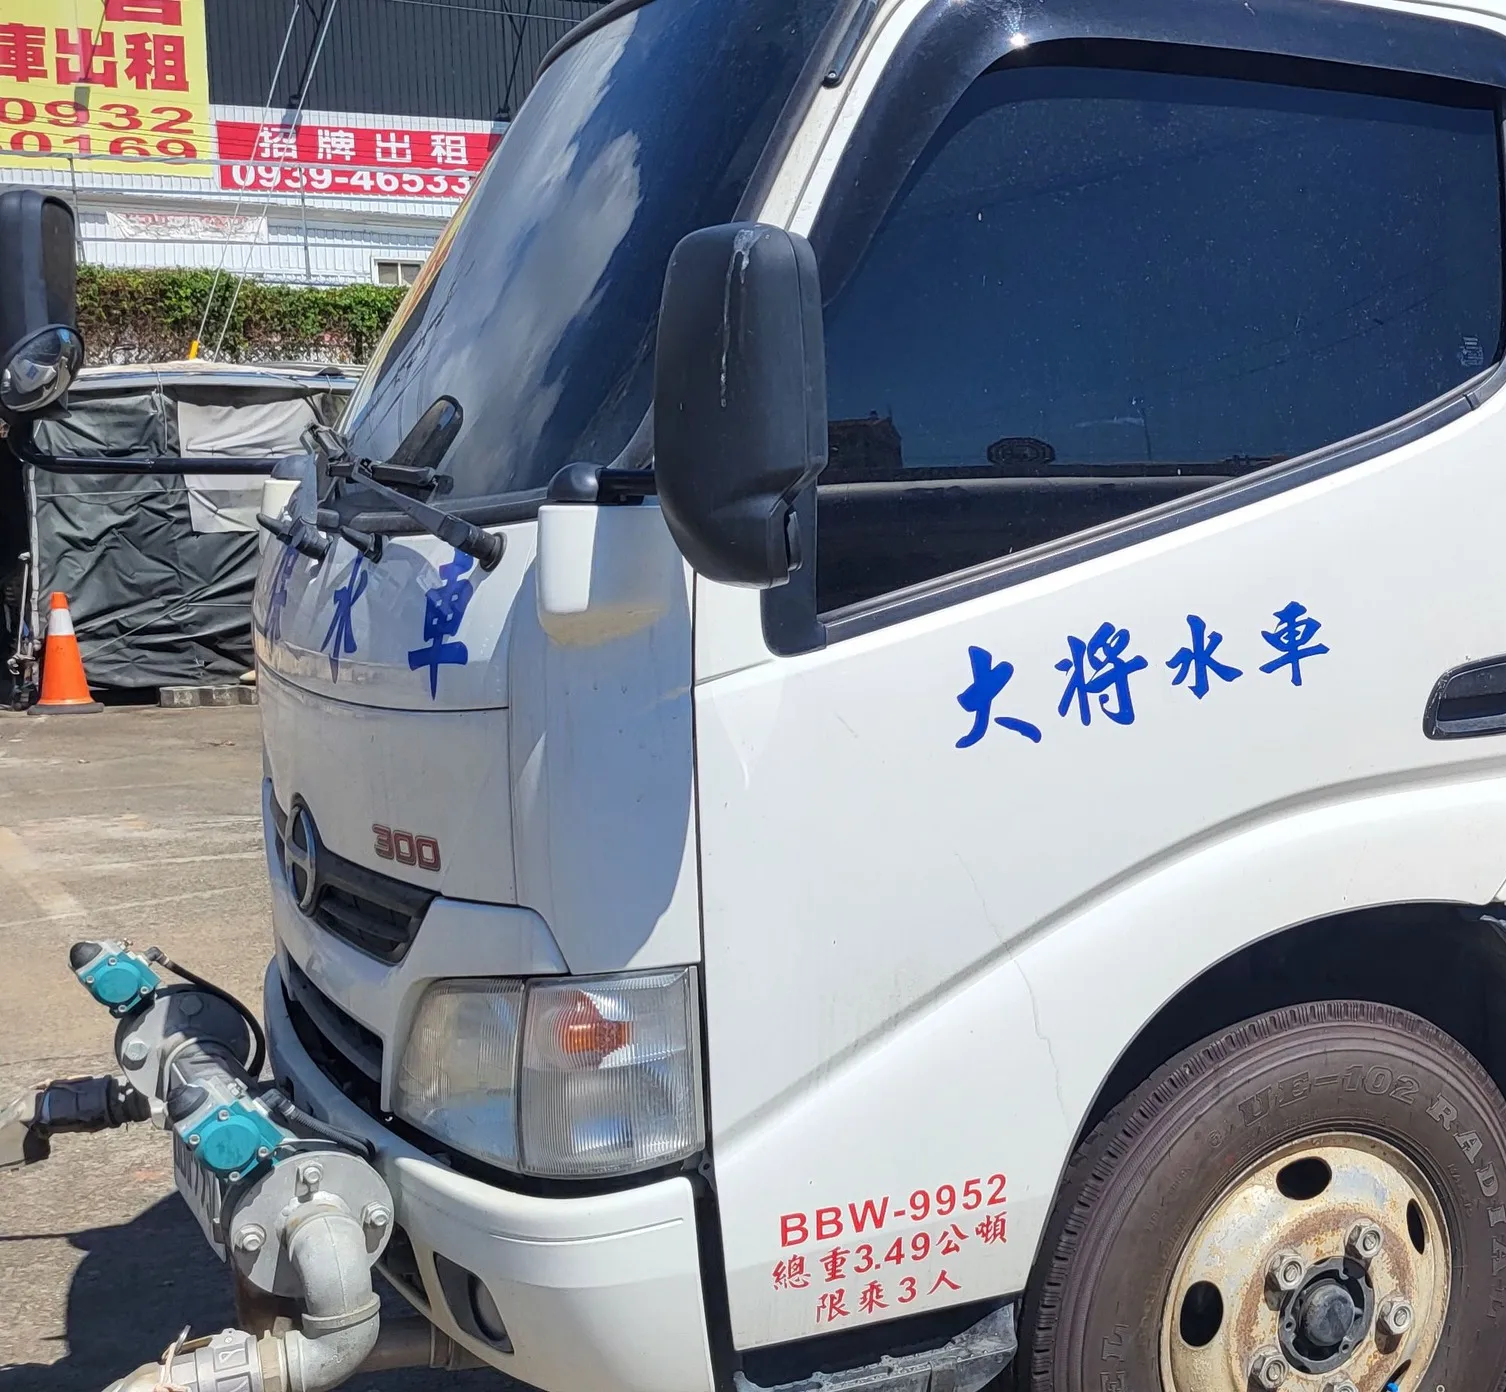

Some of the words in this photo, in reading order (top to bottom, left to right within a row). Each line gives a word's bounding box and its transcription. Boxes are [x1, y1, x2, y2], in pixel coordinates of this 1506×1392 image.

[0, 130, 197, 165] 0169
[258, 127, 468, 164] 招牌出租
[371, 824, 441, 872] 300
[780, 1173, 1007, 1247] BBW-9952
[816, 1269, 962, 1324] 限乘3人
